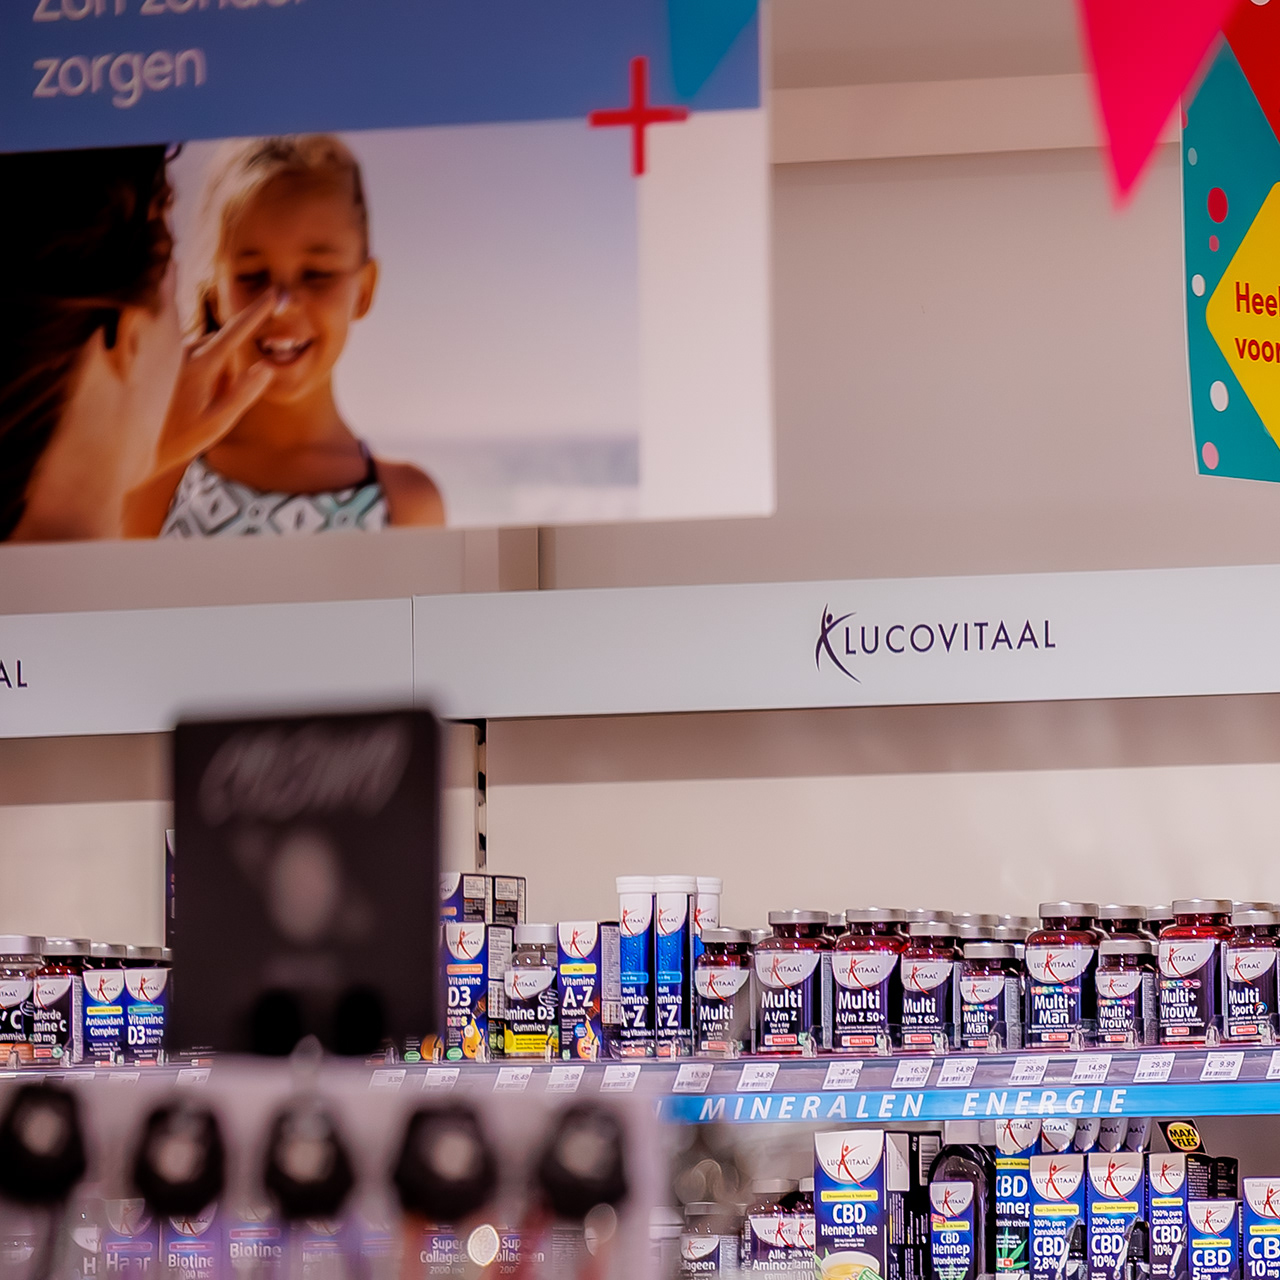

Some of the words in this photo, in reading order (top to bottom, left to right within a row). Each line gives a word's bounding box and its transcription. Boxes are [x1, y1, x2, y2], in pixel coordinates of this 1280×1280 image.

[33, 48, 207, 109] zorgen
[447, 976, 481, 986] Vitamine
[562, 977, 595, 987] Vitamine
[447, 987, 471, 1006] D3
[563, 987, 593, 1006] A-Z
[761, 991, 802, 1008] Multi
[838, 991, 881, 1009] Multi
[1034, 994, 1076, 1009] Multi+
[1161, 990, 1197, 1004] Multi+
[1228, 989, 1260, 1004] Multi
[700, 1005, 734, 1020] Multi
[903, 999, 936, 1013] Multi
[1160, 1006, 1198, 1018] Vrouw
[1231, 1005, 1254, 1015] Sport
[1040, 1011, 1069, 1024] Man
[699, 1093, 924, 1120] MINERALEN
[962, 1089, 1127, 1116] ENERGIE
[833, 1204, 866, 1223] CBD
[821, 1224, 854, 1237] Hennep
[856, 1224, 877, 1234] thee
